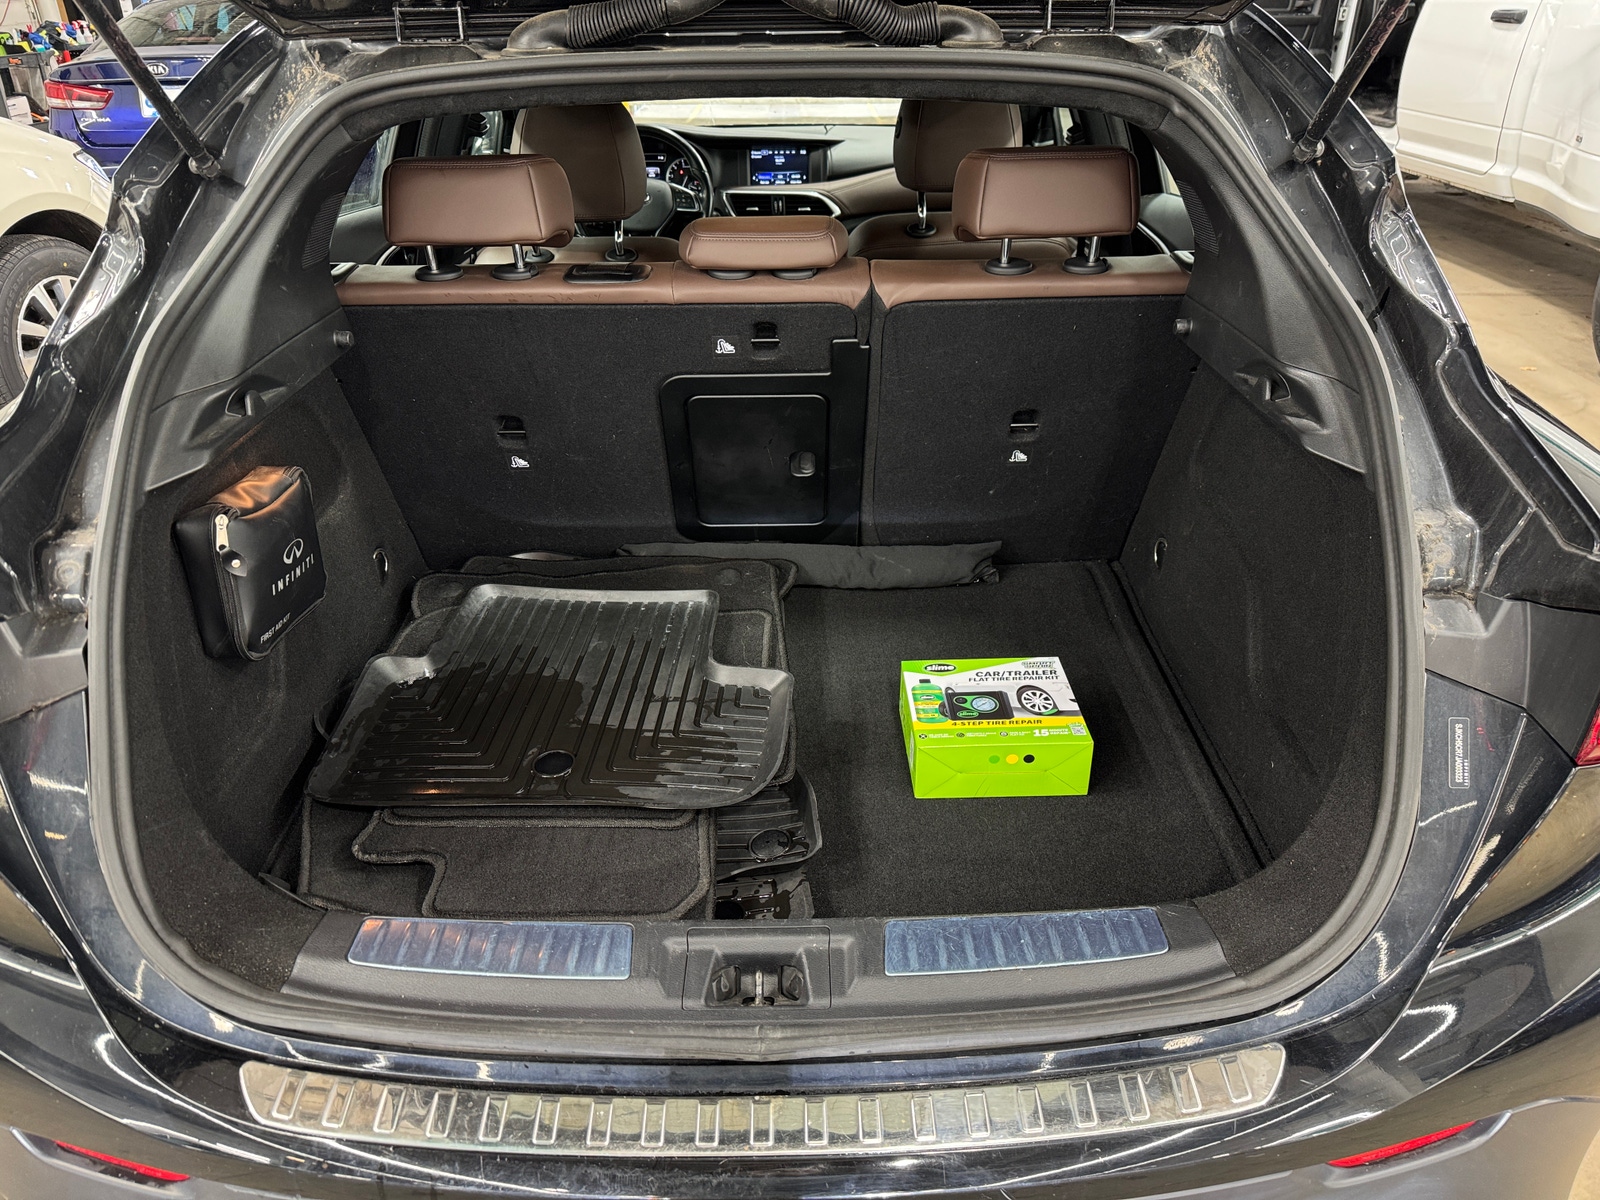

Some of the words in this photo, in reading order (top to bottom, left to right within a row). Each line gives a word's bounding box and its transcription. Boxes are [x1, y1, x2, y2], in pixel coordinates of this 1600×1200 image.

[147, 66, 165, 75] KIA
[272, 553, 314, 596] INFINITI
[260, 626, 275, 644] FIRST
[275, 619, 283, 631] AID
[1033, 728, 1049, 737] 15
